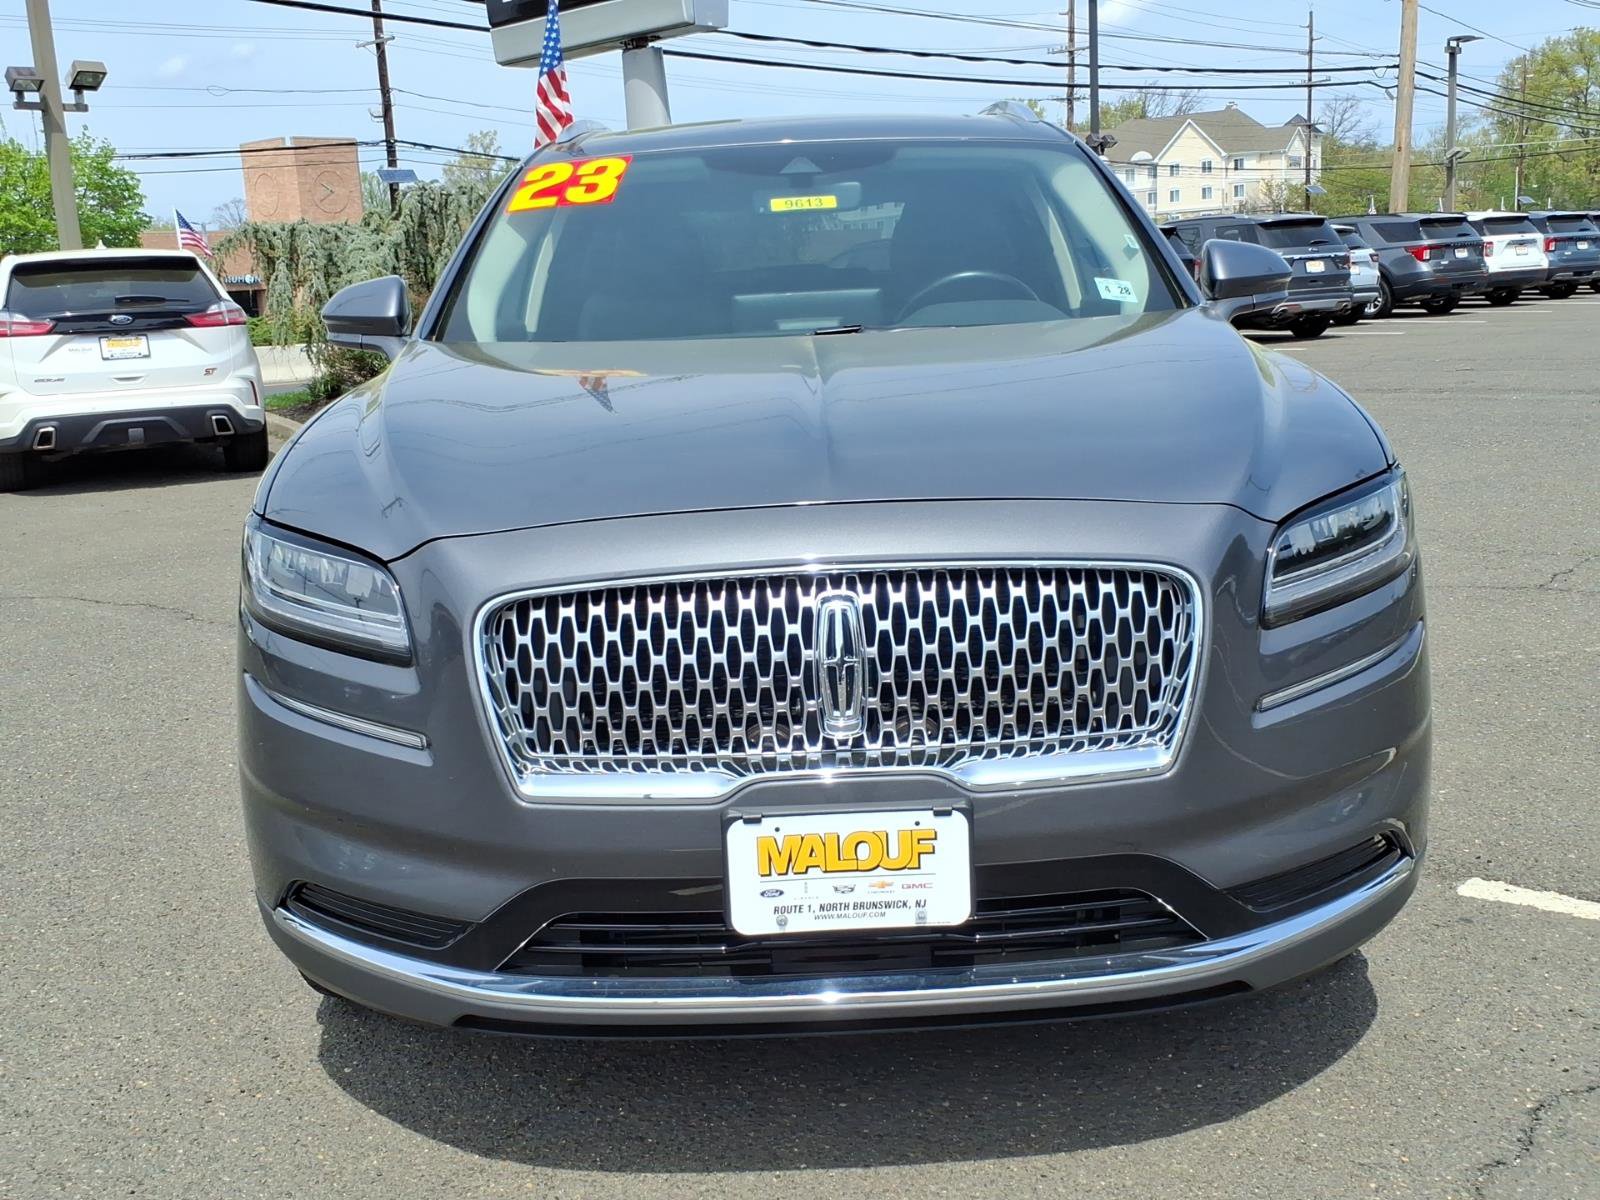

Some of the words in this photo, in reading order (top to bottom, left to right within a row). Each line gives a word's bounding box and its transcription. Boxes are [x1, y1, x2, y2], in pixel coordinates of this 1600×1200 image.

[507, 156, 627, 213] 23
[784, 197, 824, 209] 9613
[1117, 286, 1131, 295] 28
[756, 829, 937, 877] MALOUF
[901, 882, 933, 890] GMC
[773, 904, 803, 915] ROUTE
[819, 901, 849, 913] NORTH
[853, 899, 912, 911] BRUNSWICK,
[915, 899, 927, 909] NJ
[814, 911, 885, 920] WWW.MALOUF.COM
